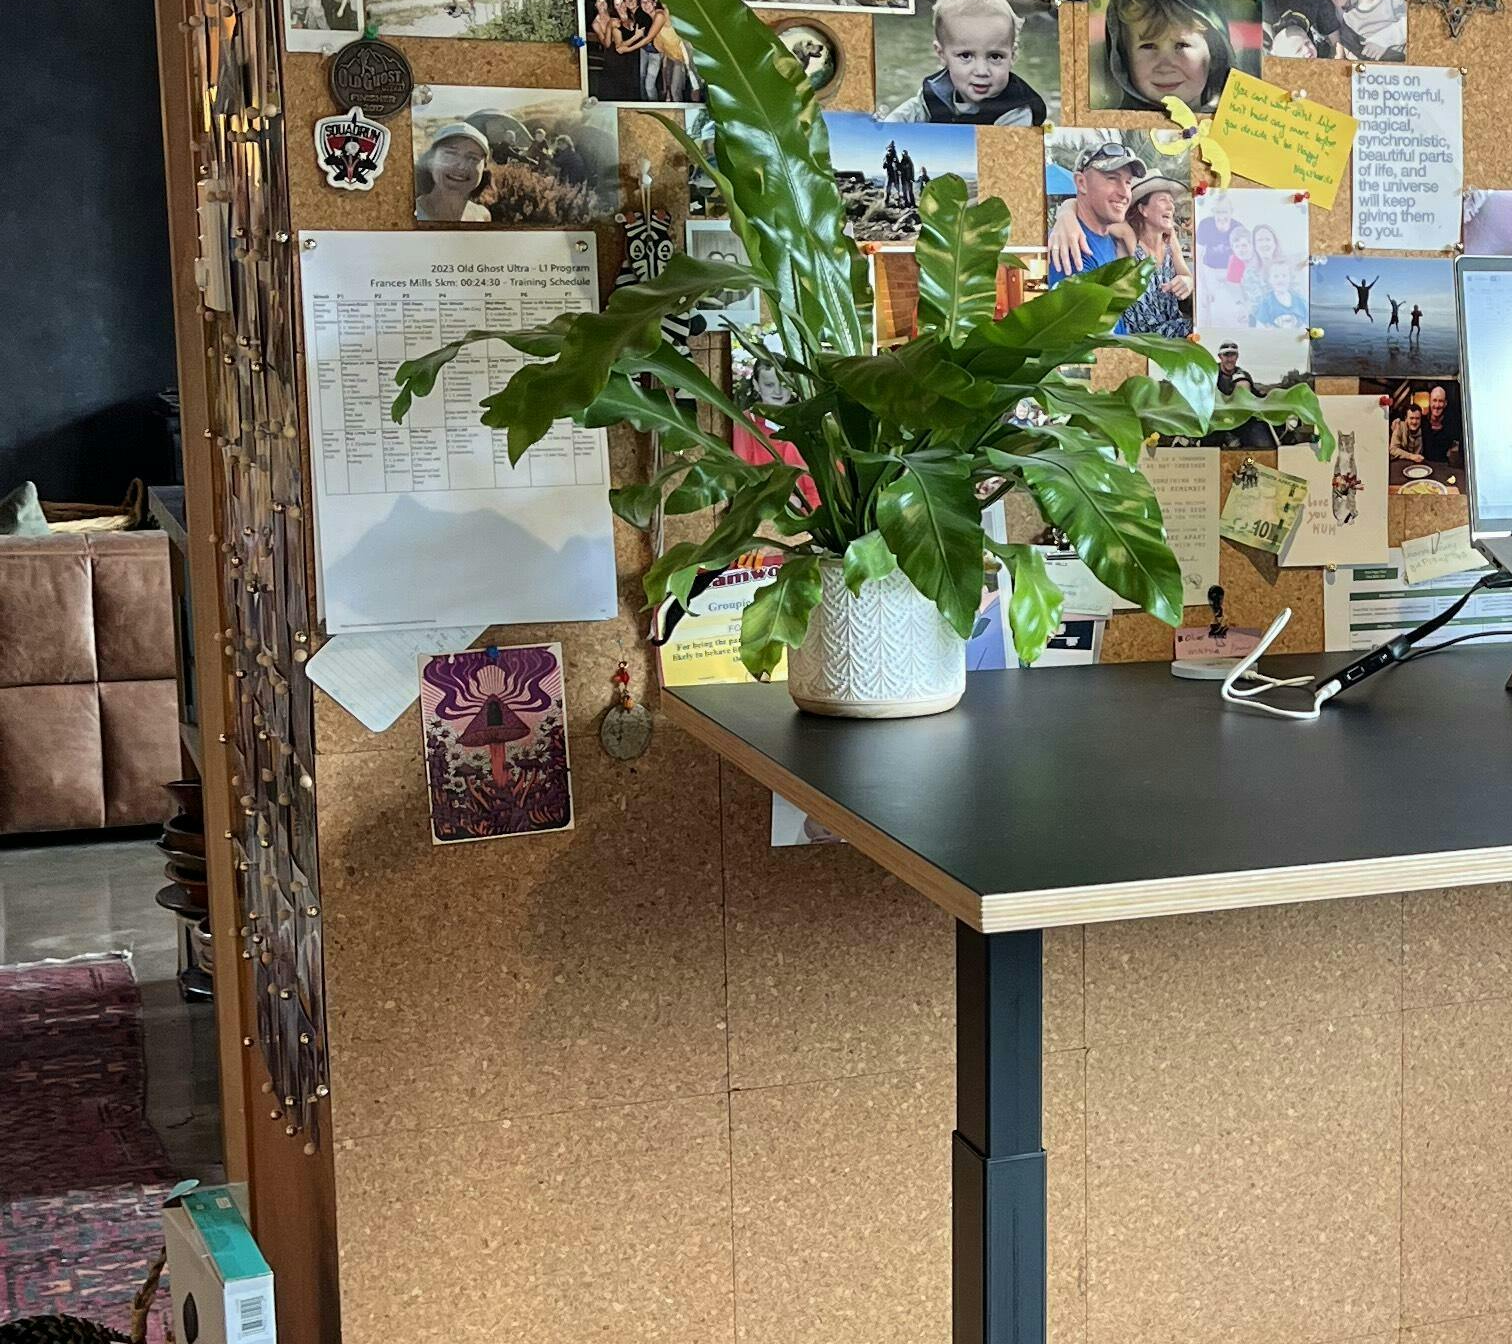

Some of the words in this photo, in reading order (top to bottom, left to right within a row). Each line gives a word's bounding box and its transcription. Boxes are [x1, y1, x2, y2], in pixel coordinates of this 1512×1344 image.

[363, 70, 401, 91] GHOST
[1357, 73, 1400, 86] Focus
[1403, 75, 1420, 86] on
[1358, 88, 1379, 100] the
[1383, 88, 1445, 105] powerful,
[1358, 105, 1421, 119] euphoric,
[1358, 120, 1414, 134] magical,
[1358, 135, 1450, 149] synchronistic,
[1358, 149, 1414, 162] beautiful
[1419, 151, 1453, 165] parts
[1358, 164, 1371, 177] of
[1375, 164, 1397, 179] life,
[1401, 164, 1427, 177] and
[1358, 178, 1379, 191] the
[1383, 180, 1439, 192] universe
[1358, 193, 1380, 206] will
[1383, 193, 1416, 210] keep
[1358, 209, 1397, 225] giving
[1401, 209, 1435, 223] them
[1358, 225, 1372, 237] to
[1375, 226, 1403, 241] you.
[431, 264, 454, 273] 2023
[457, 264, 474, 273] Old
[476, 263, 504, 273] Ghost
[507, 263, 530, 273] Ultra
[550, 263, 590, 275] Program
[370, 278, 407, 288] Frances
[409, 278, 432, 287] Mills
[460, 278, 501, 287] 00:24:30
[510, 277, 547, 288] Training
[550, 277, 591, 287] Schedule
[1253, 519, 1271, 538] 10
[716, 638, 727, 646] the
